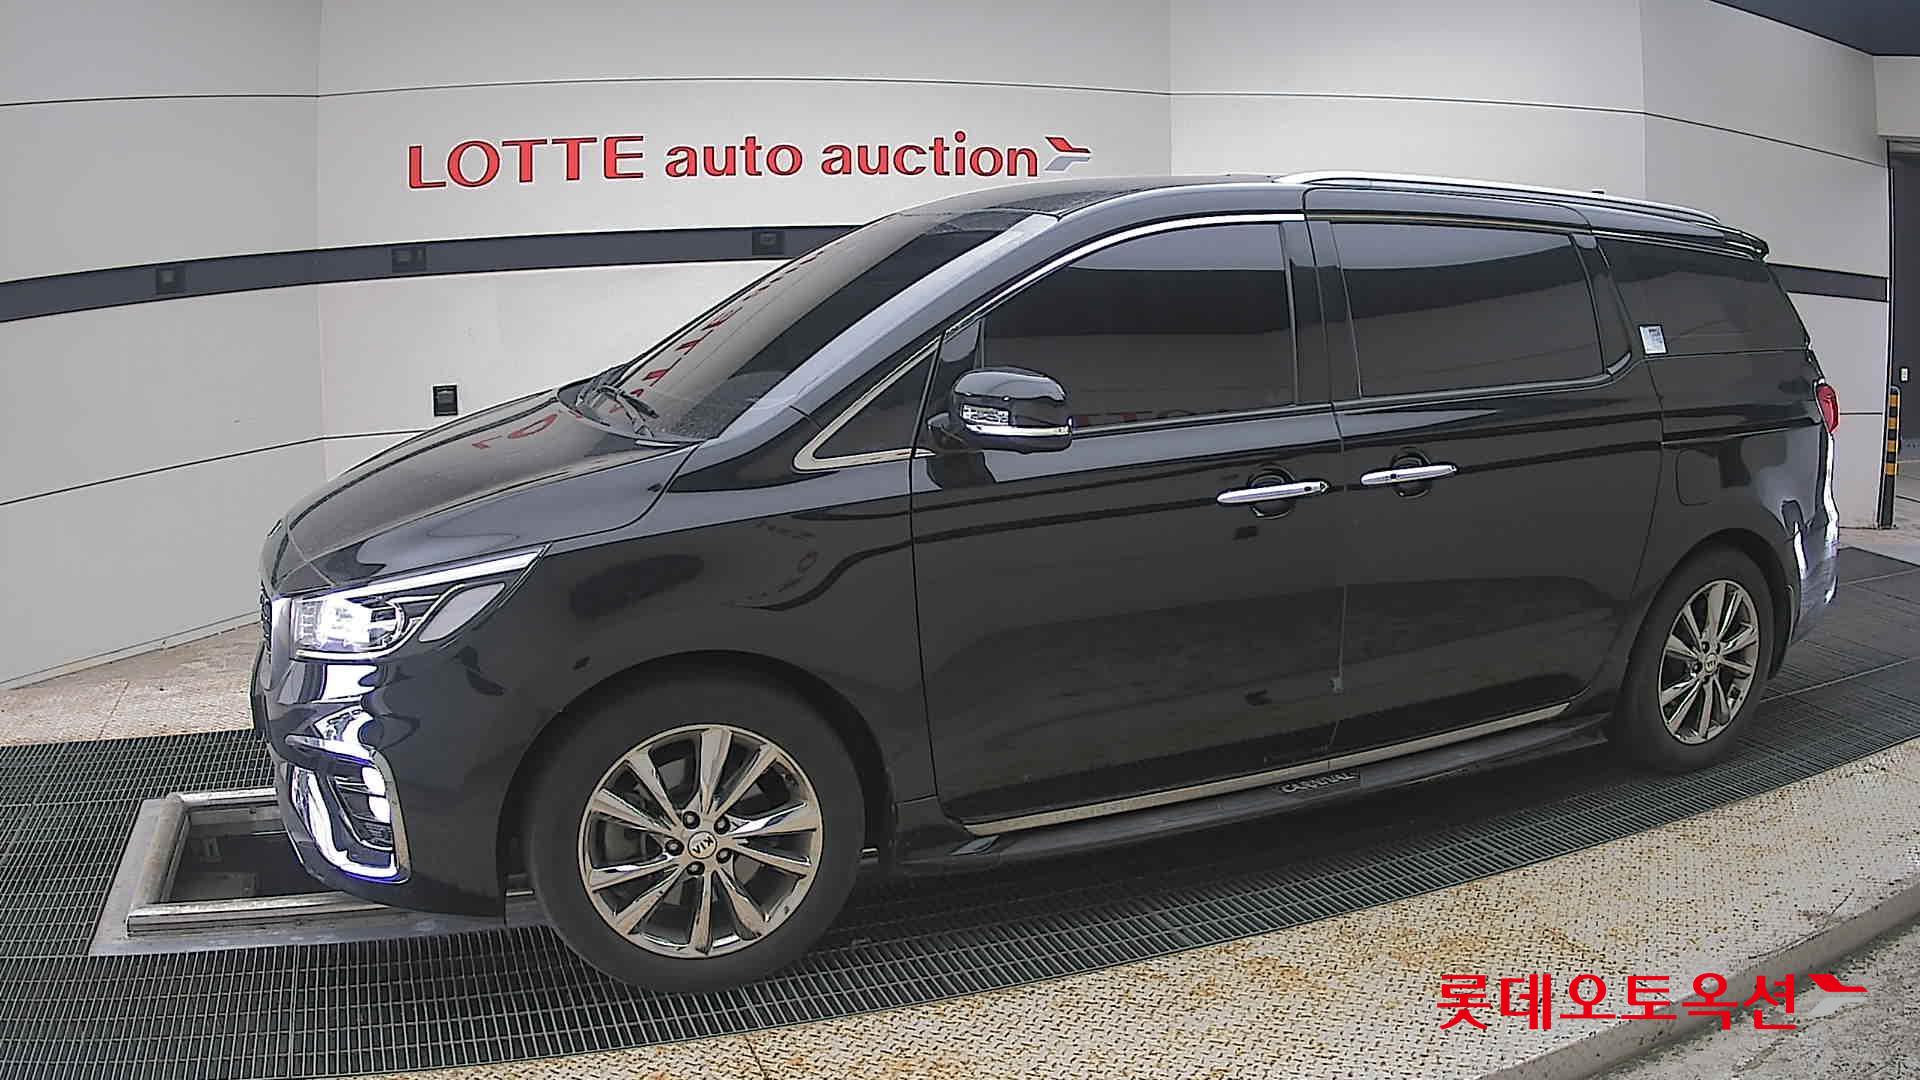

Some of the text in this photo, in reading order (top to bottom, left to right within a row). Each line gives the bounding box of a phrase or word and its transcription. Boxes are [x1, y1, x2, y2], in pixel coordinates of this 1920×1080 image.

[408, 131, 1038, 189] LOTTE auto auction
